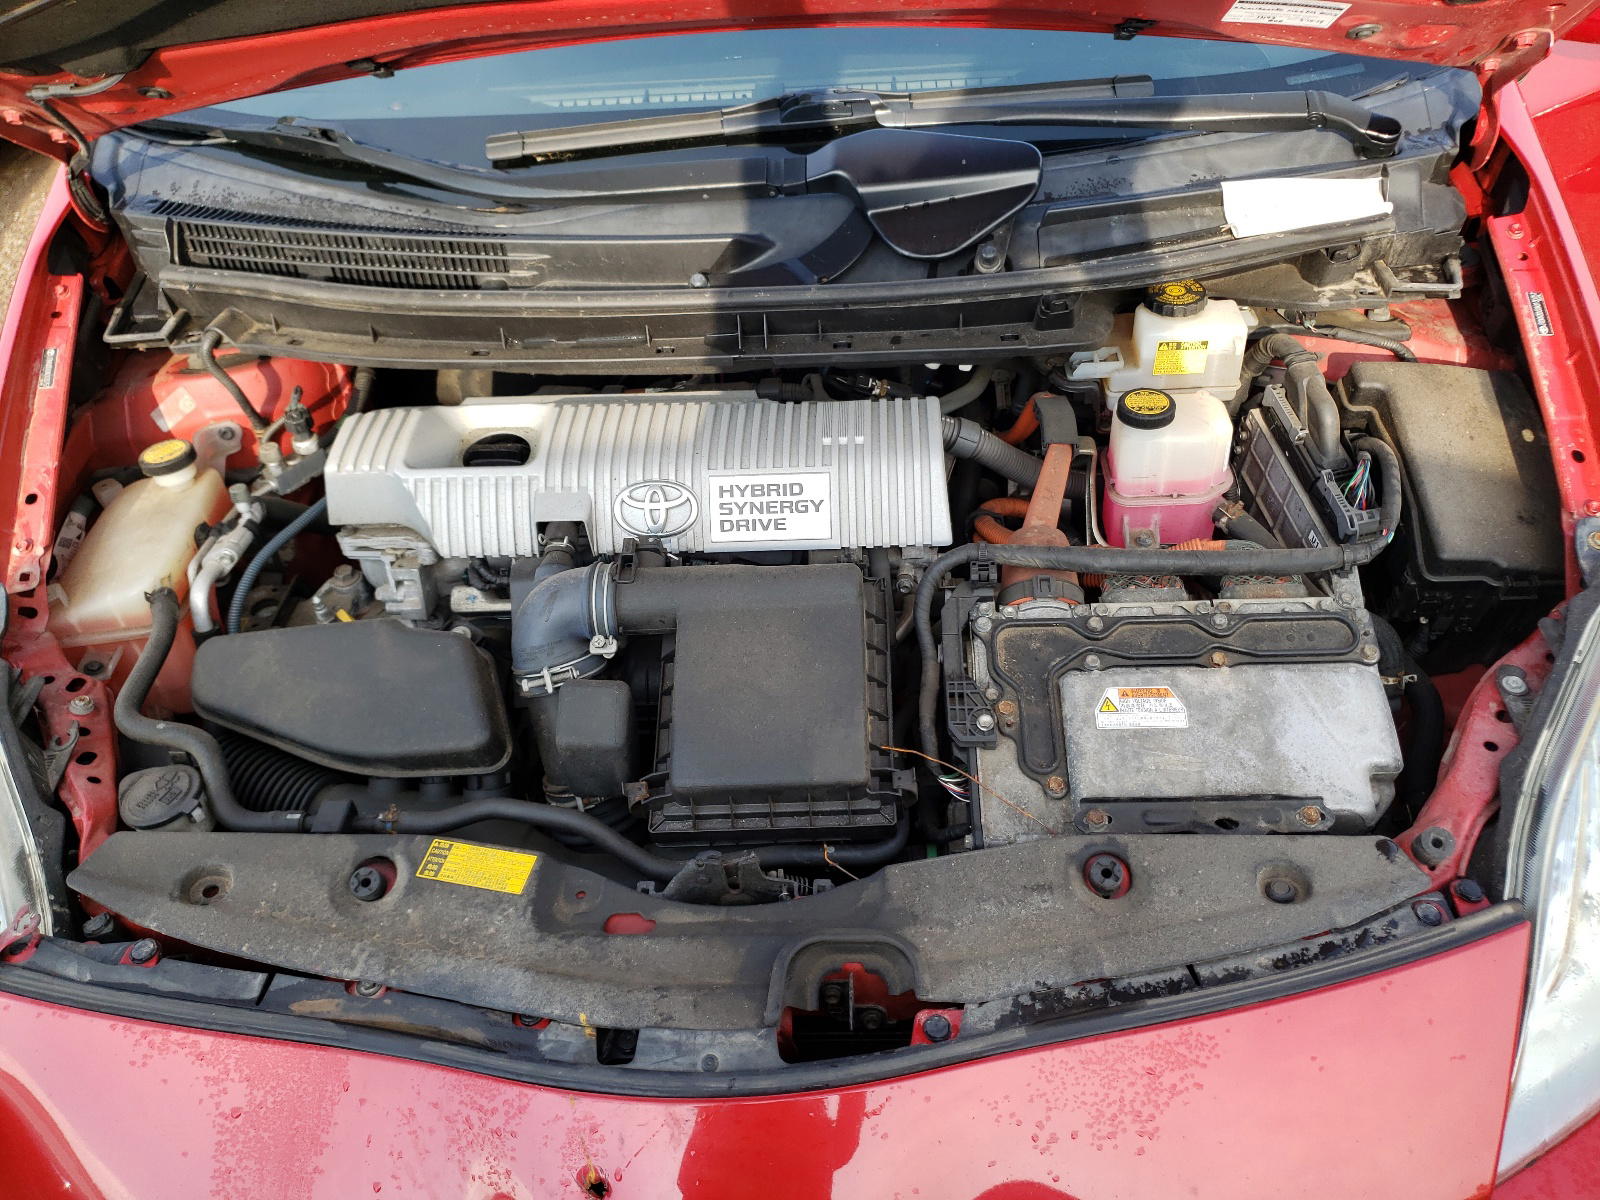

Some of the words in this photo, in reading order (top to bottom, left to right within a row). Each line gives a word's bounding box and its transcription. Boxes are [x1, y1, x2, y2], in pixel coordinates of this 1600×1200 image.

[719, 483, 803, 498] HYBRID
[719, 500, 824, 515] SYNERGY
[720, 518, 786, 532] DRIVE
